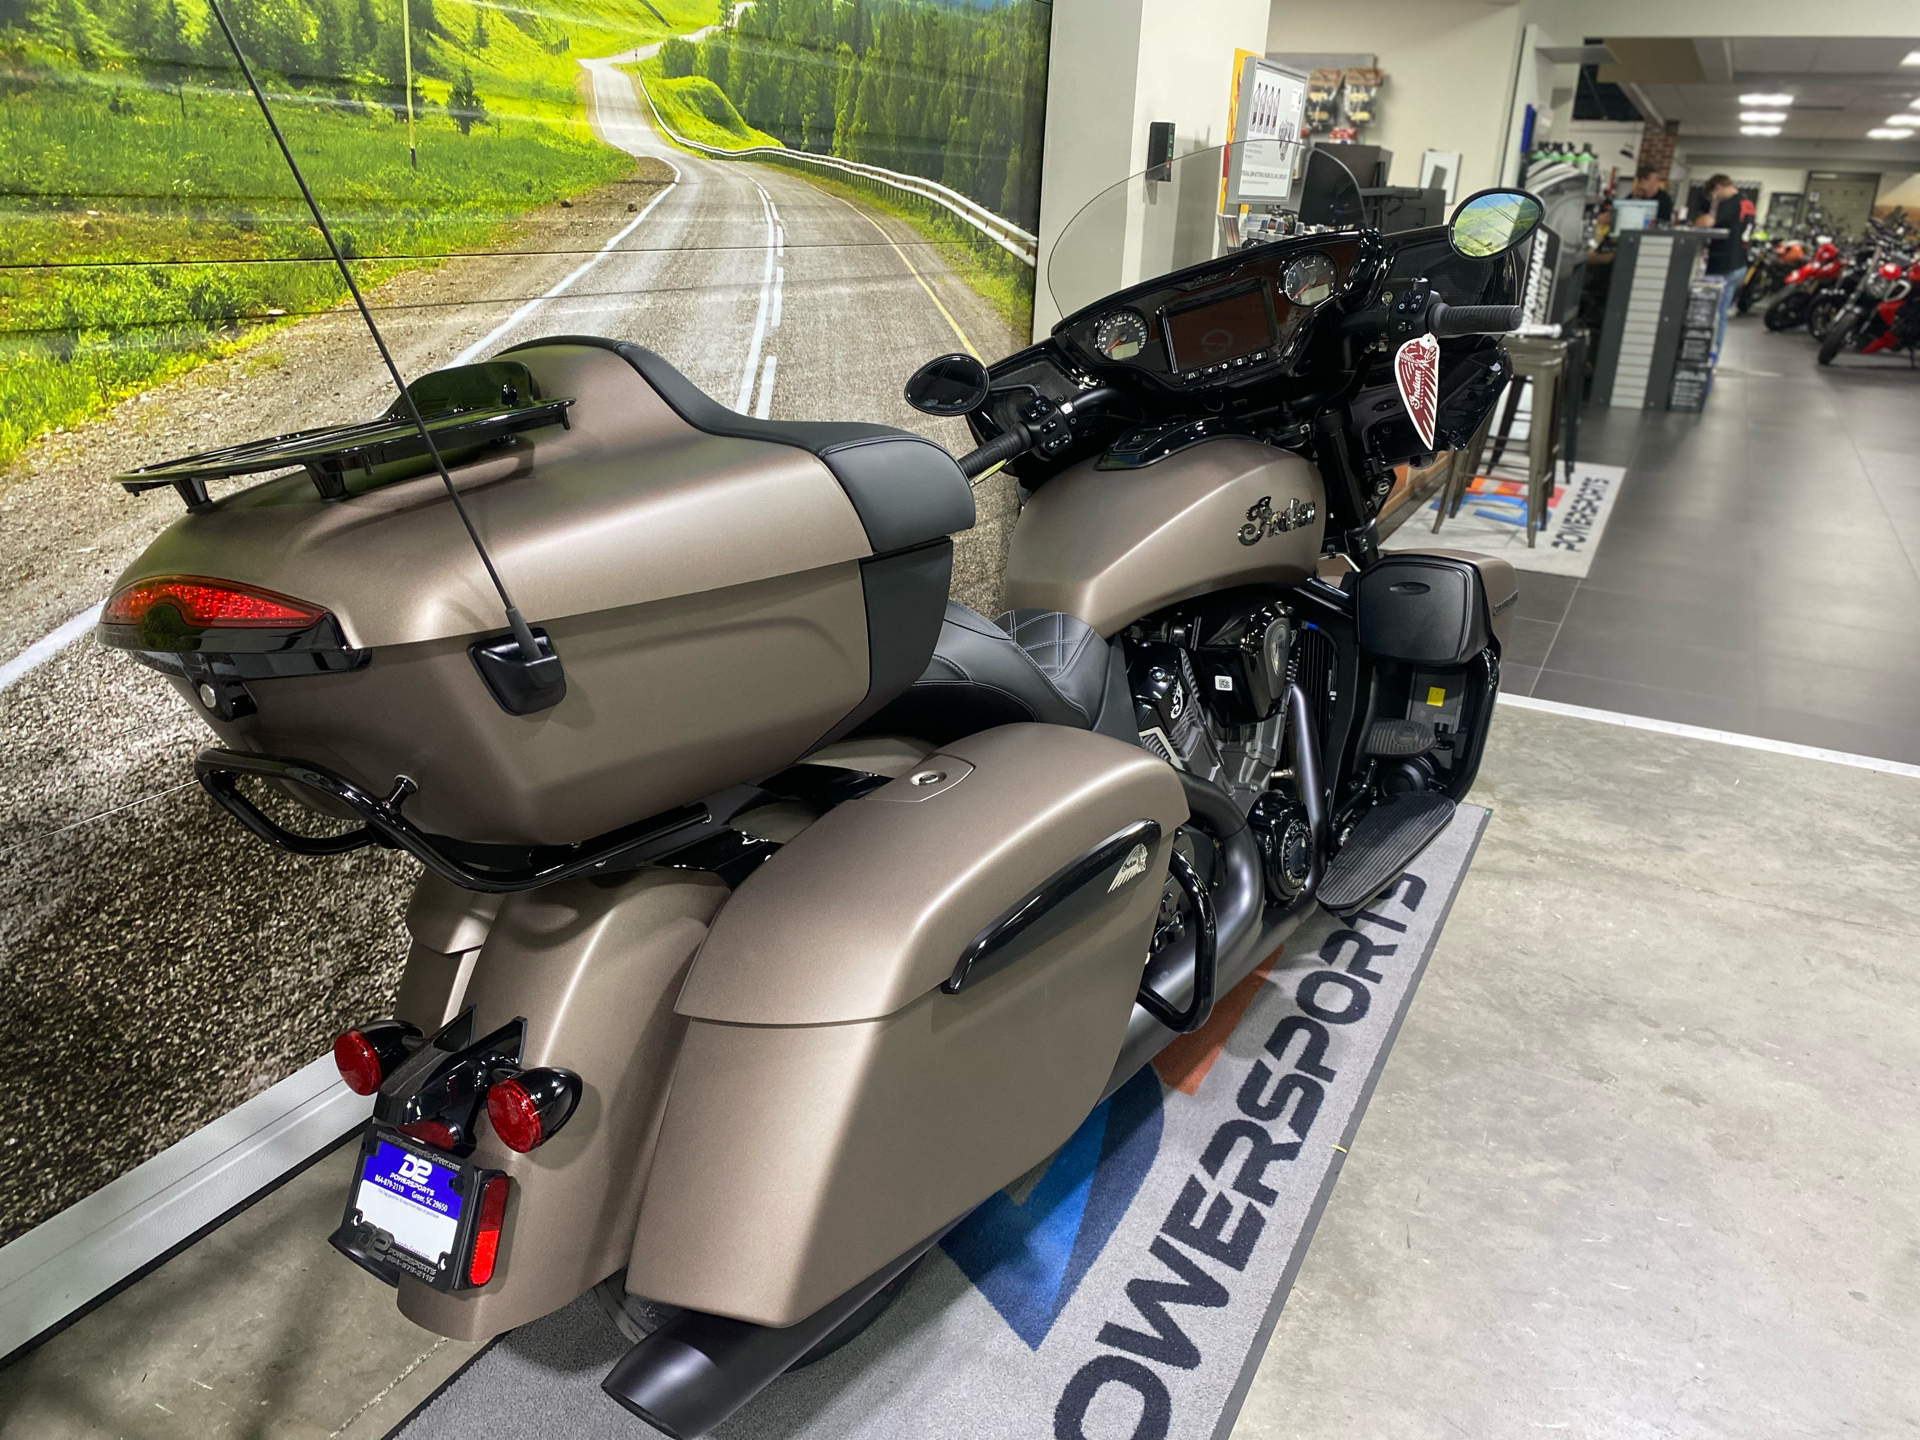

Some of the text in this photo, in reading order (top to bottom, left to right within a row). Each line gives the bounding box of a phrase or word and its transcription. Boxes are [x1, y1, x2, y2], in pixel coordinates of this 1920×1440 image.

[1409, 369, 1421, 410] Indian
[1237, 496, 1316, 546] Indian
[1551, 477, 1609, 552] POWERSPORTS
[389, 1172, 435, 1197] POWERSPORTS
[398, 1153, 433, 1185] D2
[374, 1174, 405, 1193] 864-879-2119
[425, 1196, 433, 1206] SC
[388, 1247, 437, 1276] POWERSPORTS
